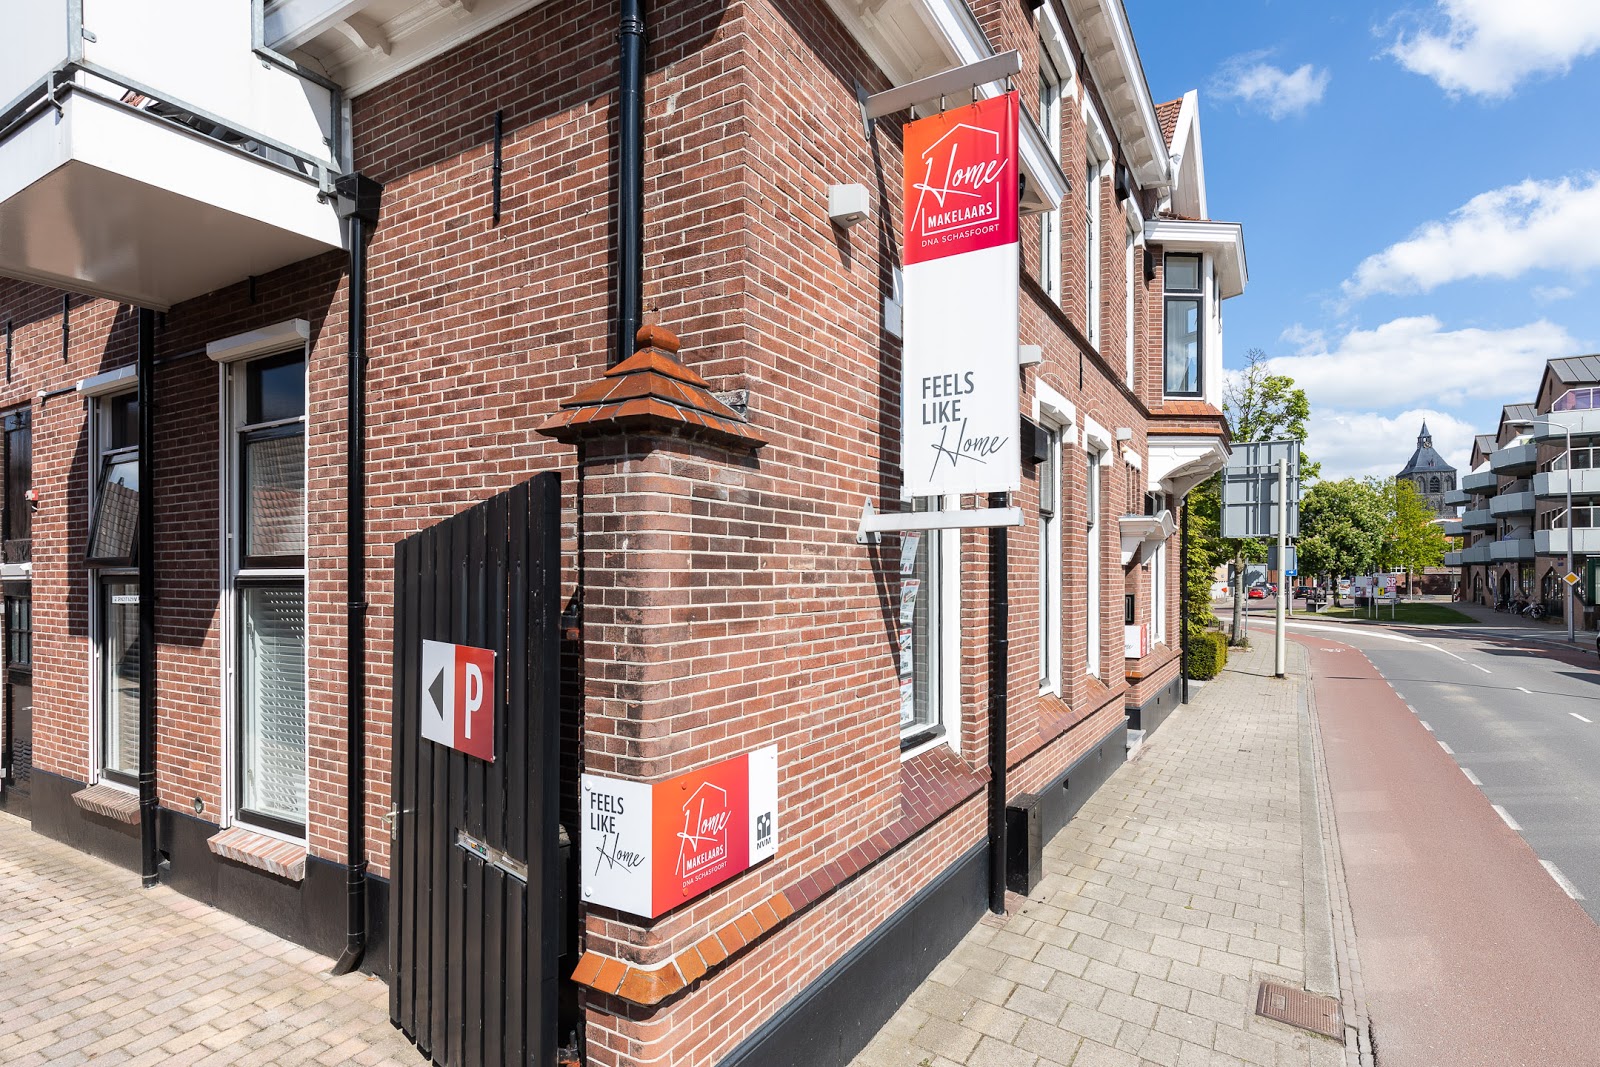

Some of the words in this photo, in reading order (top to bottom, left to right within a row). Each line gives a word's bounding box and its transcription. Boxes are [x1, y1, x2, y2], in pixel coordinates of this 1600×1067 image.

[911, 143, 1008, 231] Home
[928, 201, 993, 228] MAKELAARS
[921, 237, 939, 248] DNA
[942, 223, 1000, 243] SCHASFOORT
[922, 371, 975, 399] FEELS
[922, 399, 961, 425] LIKE
[929, 417, 1009, 482] Home
[465, 662, 484, 739] P
[590, 791, 624, 815] FEELS
[590, 812, 616, 834] LIKE
[675, 797, 731, 876] Home
[595, 832, 646, 876] Home
[756, 837, 772, 850] NVM
[686, 845, 724, 871] MAKELAARS
[682, 877, 694, 888] DNA
[695, 860, 728, 882] SCHASFOORT
